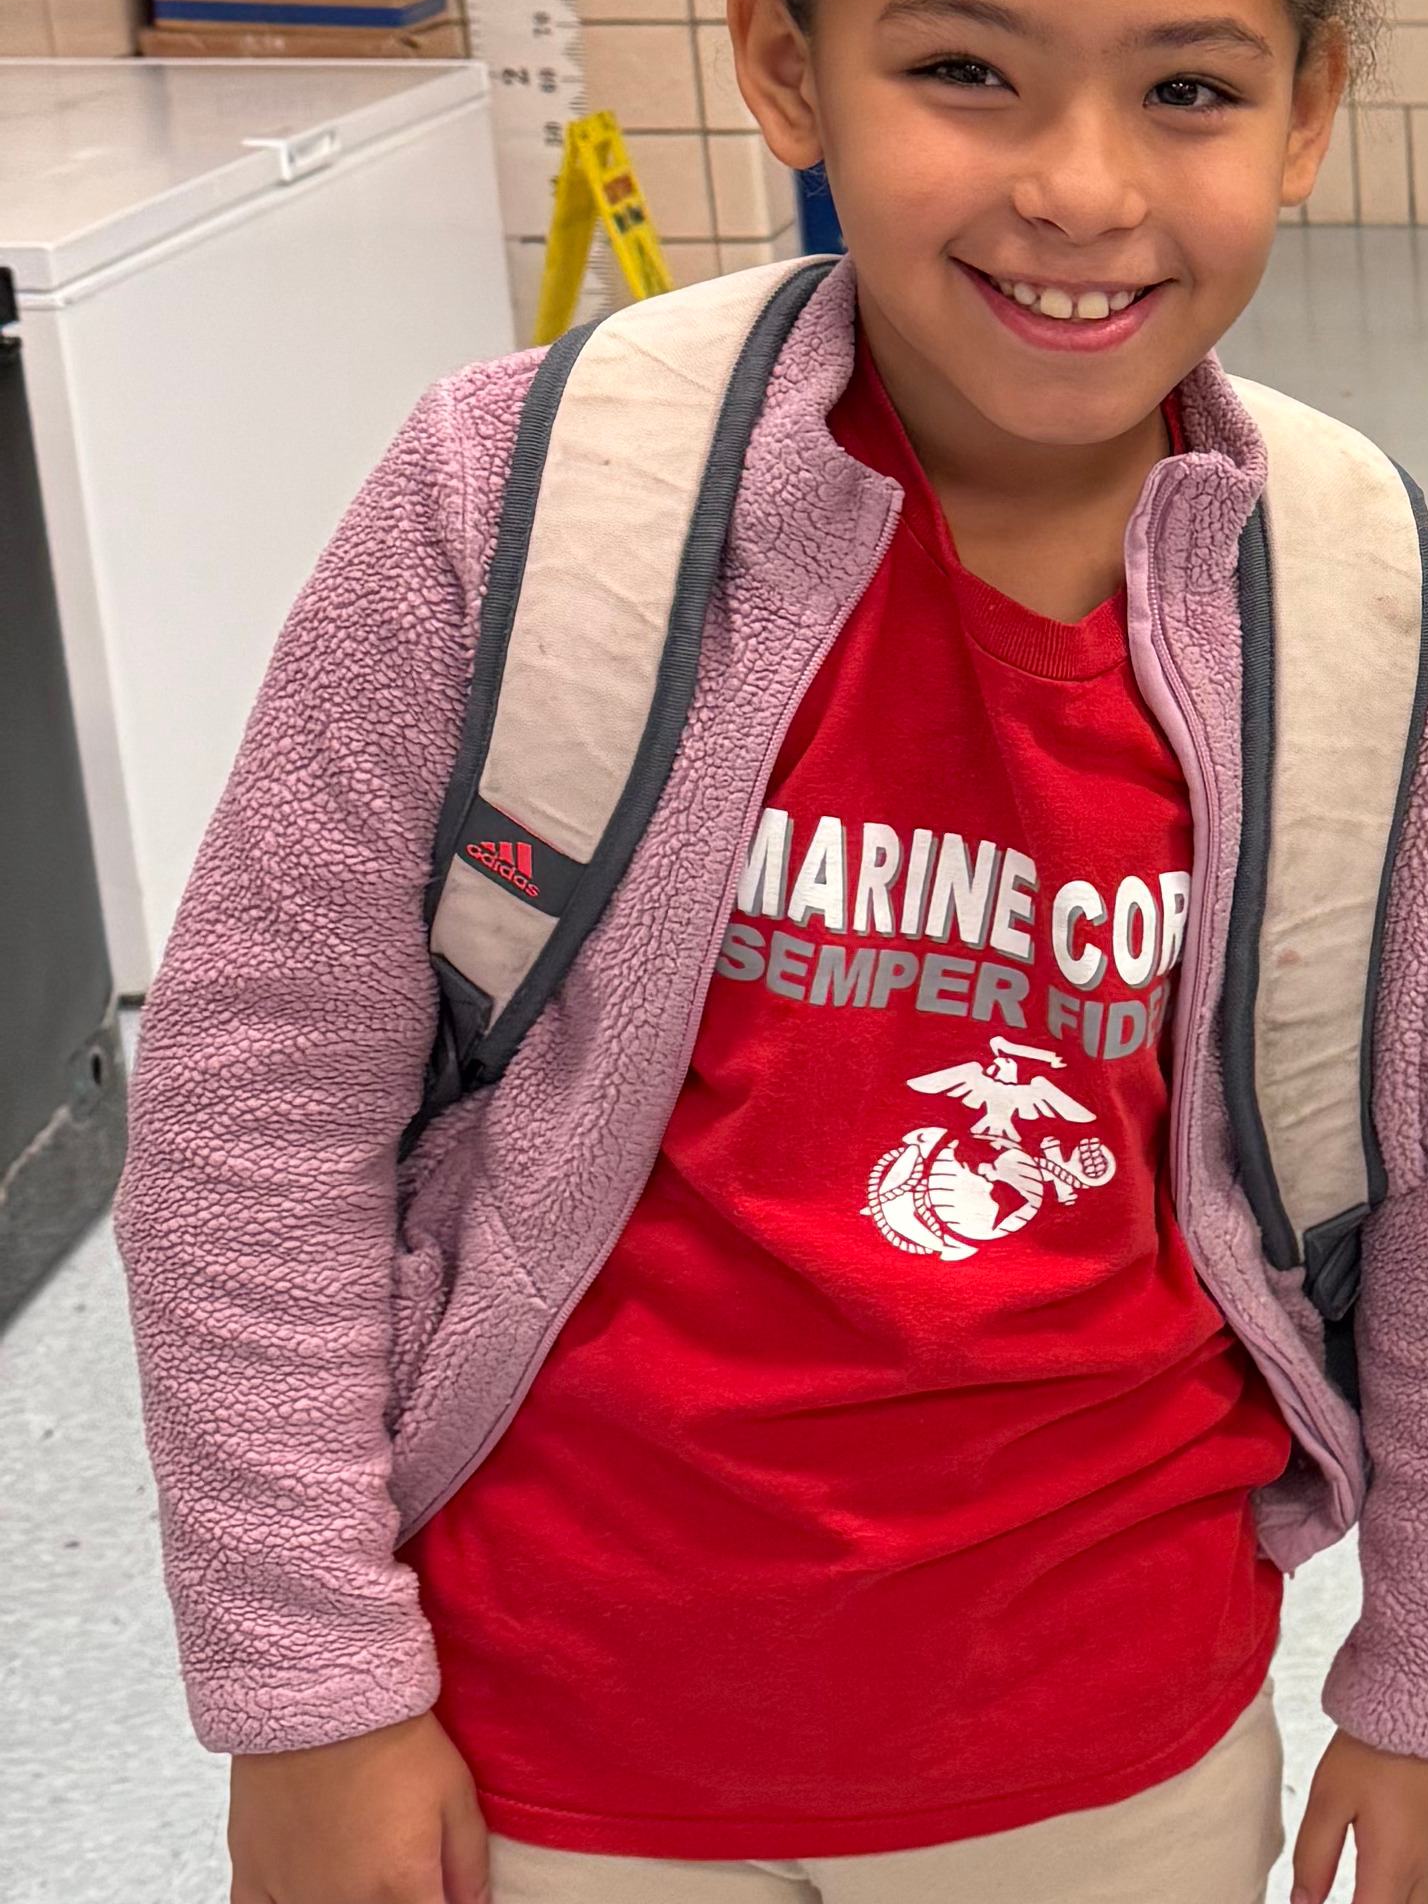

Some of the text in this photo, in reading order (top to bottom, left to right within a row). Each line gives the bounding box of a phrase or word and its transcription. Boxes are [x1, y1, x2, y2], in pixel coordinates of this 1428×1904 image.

[502, 67, 530, 86] 2
[466, 843, 541, 897] adidas
[737, 807, 1038, 958] MARINE
[717, 925, 1030, 1029] SEMPER
